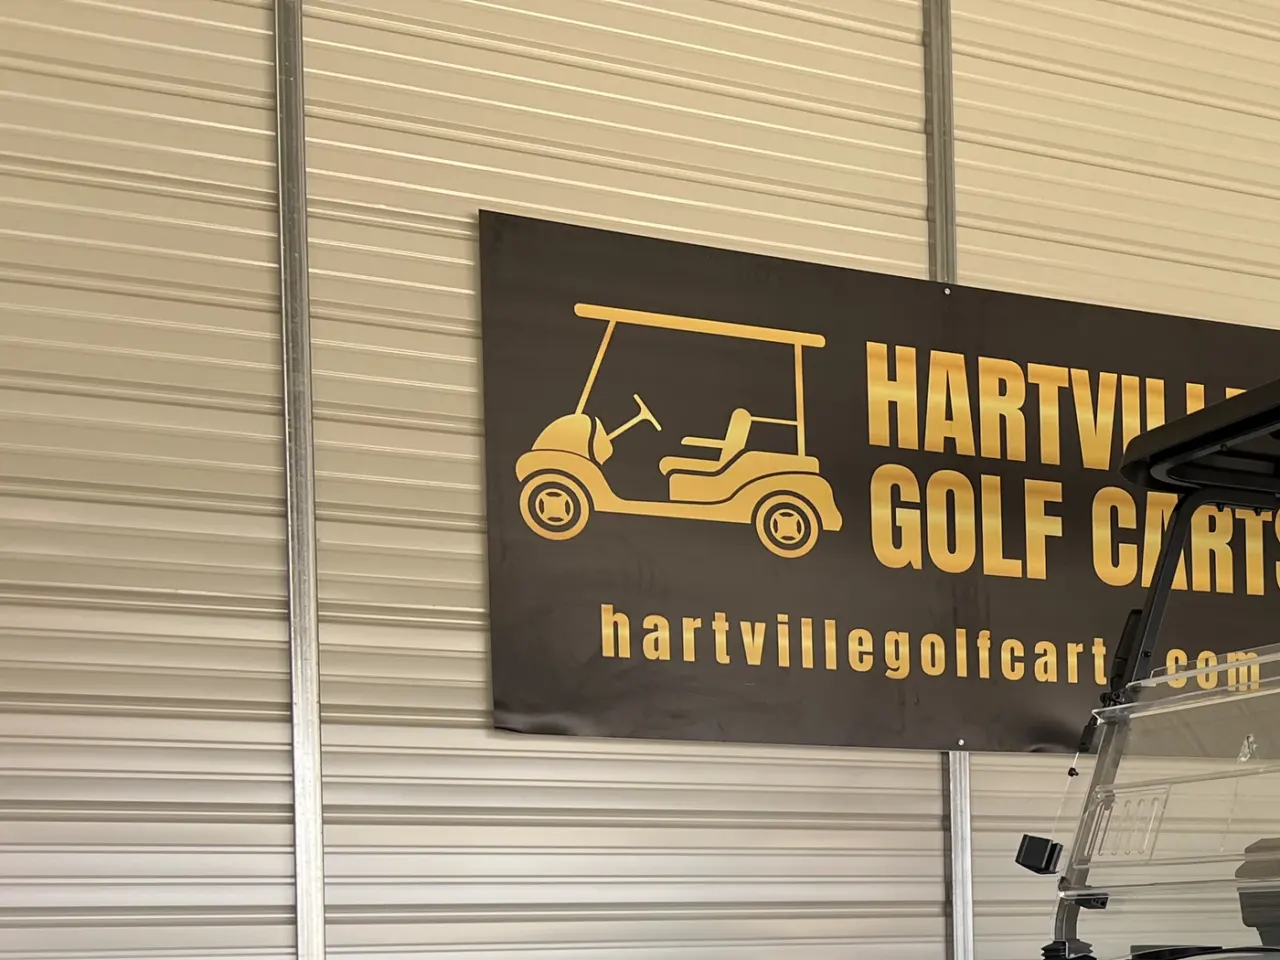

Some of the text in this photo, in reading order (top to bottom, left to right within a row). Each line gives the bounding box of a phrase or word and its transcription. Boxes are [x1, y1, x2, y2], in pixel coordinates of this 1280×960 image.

[866, 341, 1248, 471] HARTVI
[870, 463, 1063, 580] GOLF
[601, 603, 1261, 692] hartvillegolfcartcom
